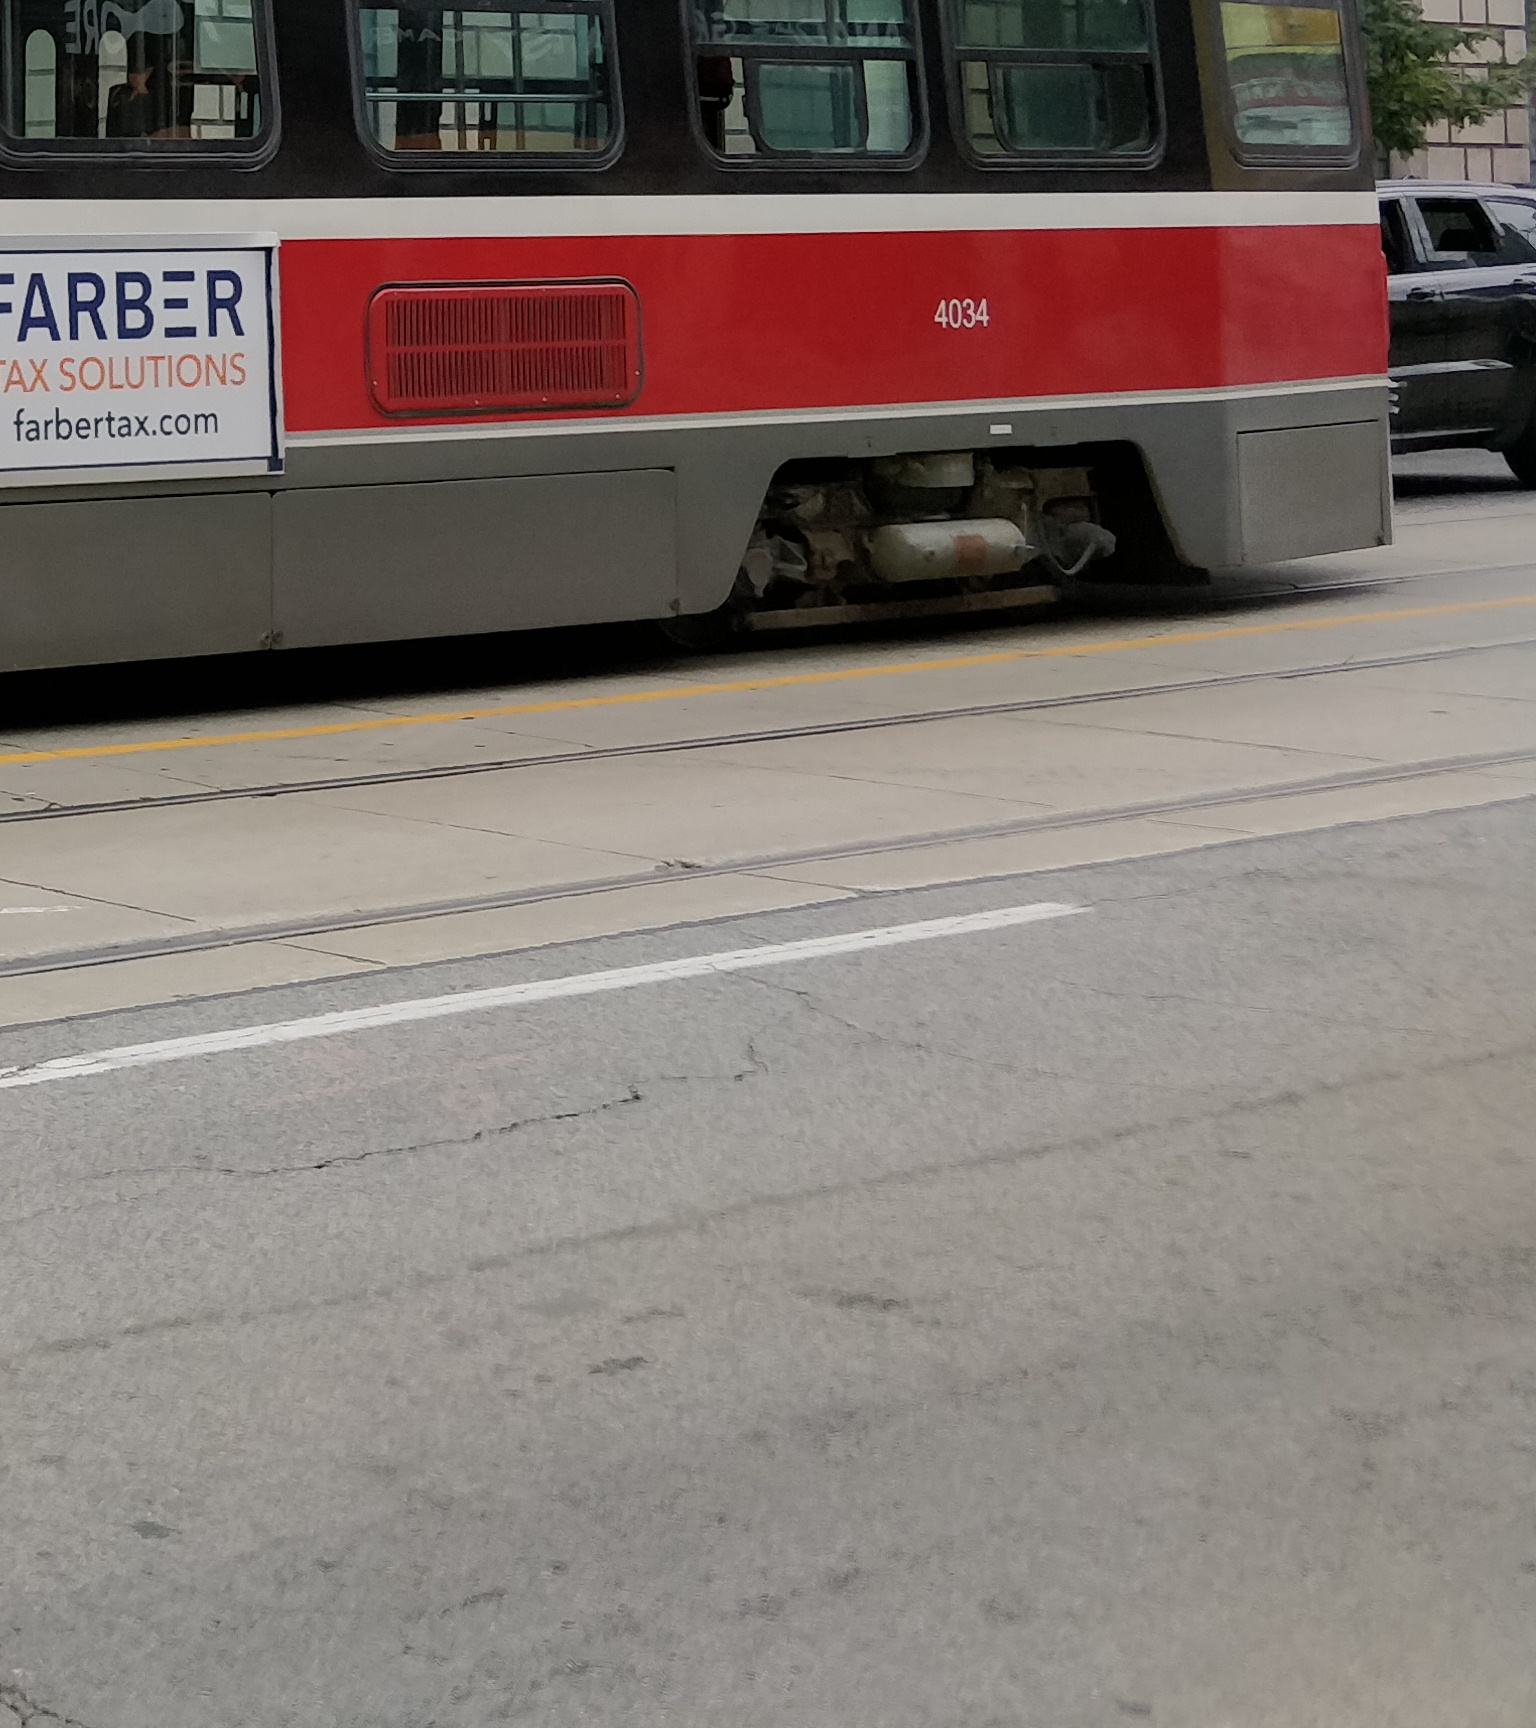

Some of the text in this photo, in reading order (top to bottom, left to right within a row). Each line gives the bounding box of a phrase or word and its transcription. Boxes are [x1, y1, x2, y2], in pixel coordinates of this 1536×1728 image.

[934, 297, 990, 329] 4034
[58, 352, 247, 392] SOLUTIONS
[13, 407, 219, 442] farbertax.com
